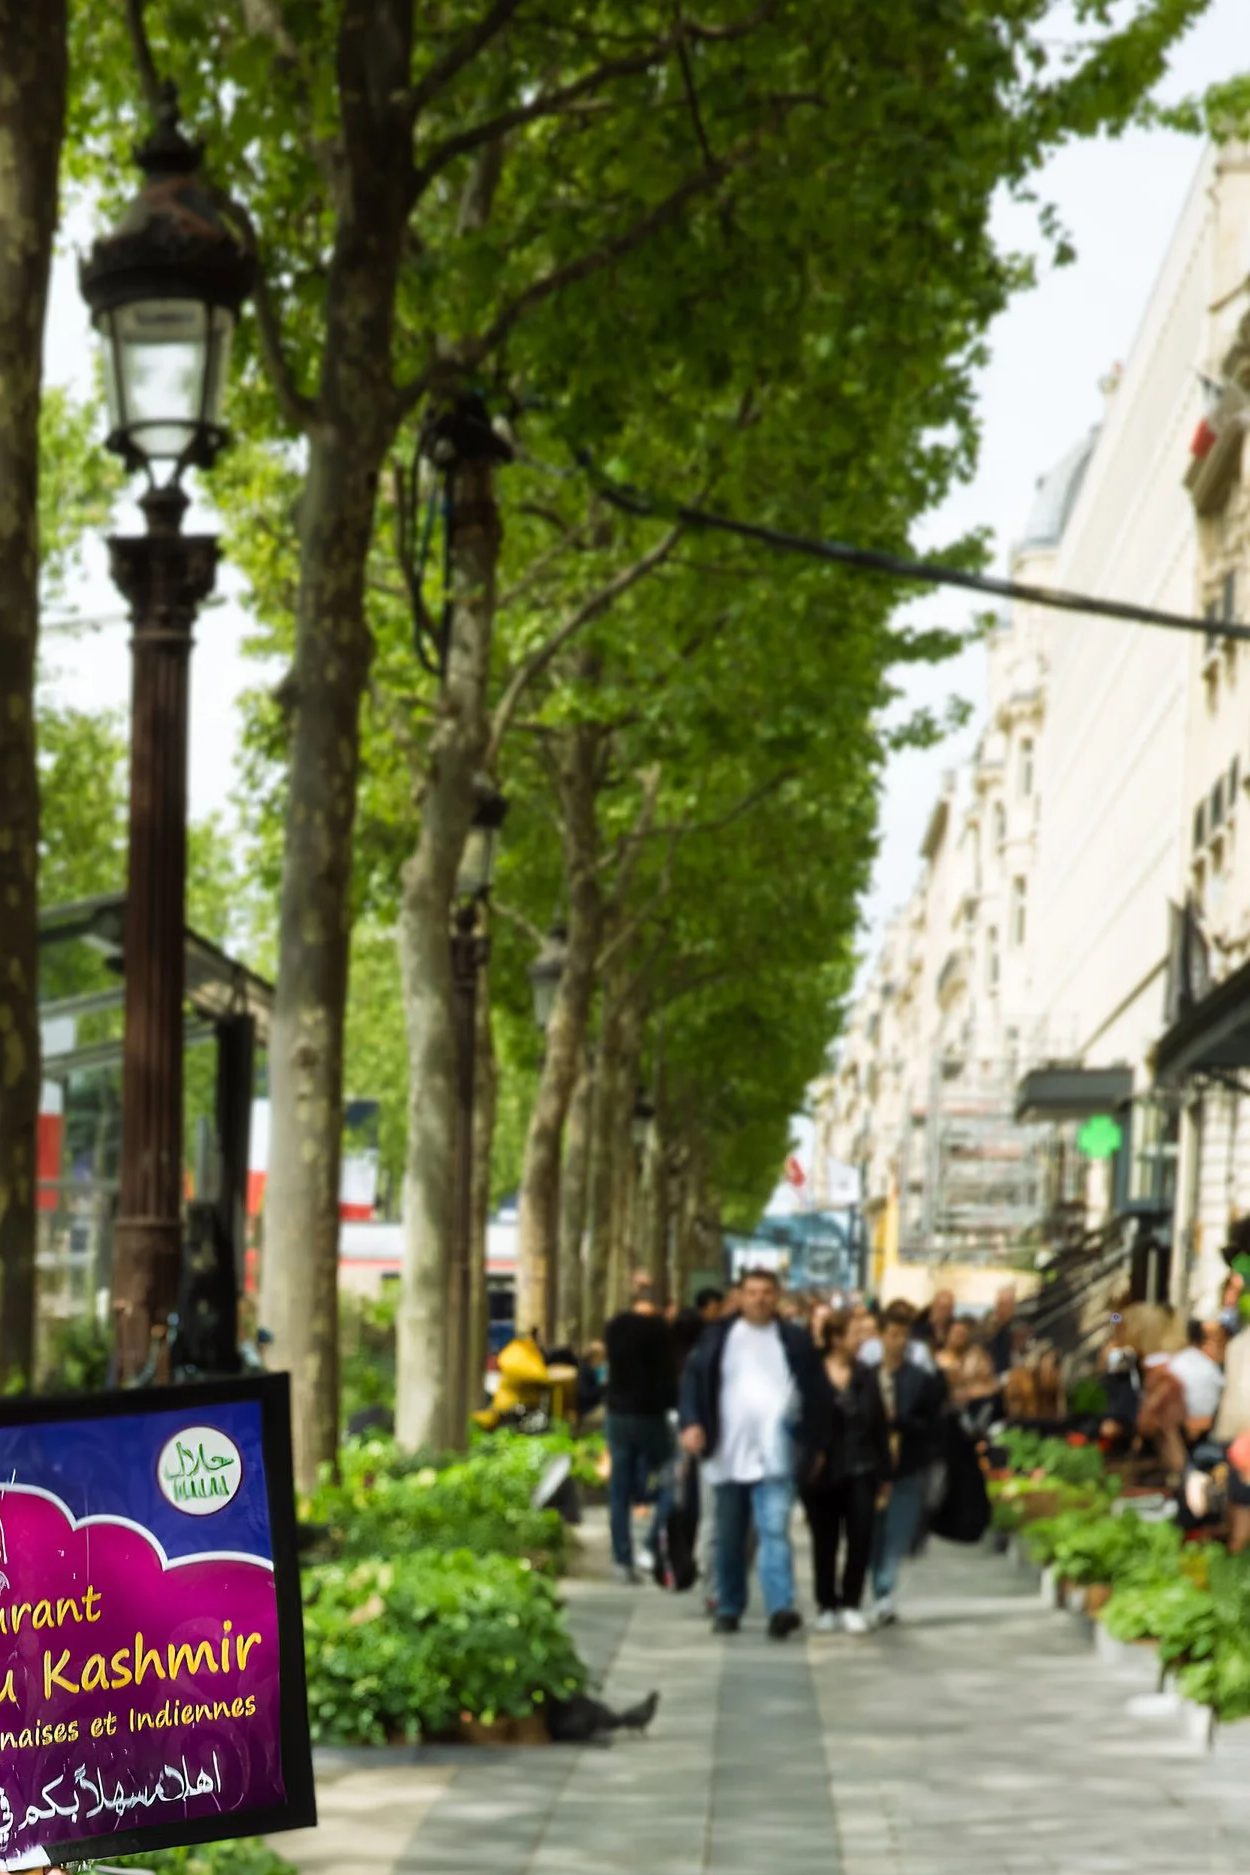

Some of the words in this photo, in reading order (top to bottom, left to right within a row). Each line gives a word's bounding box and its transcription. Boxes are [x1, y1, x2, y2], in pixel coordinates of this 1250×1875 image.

[43, 1619, 262, 1700] Kashmir
[90, 1710, 118, 1738] et
[129, 1694, 257, 1733] Indiennes
